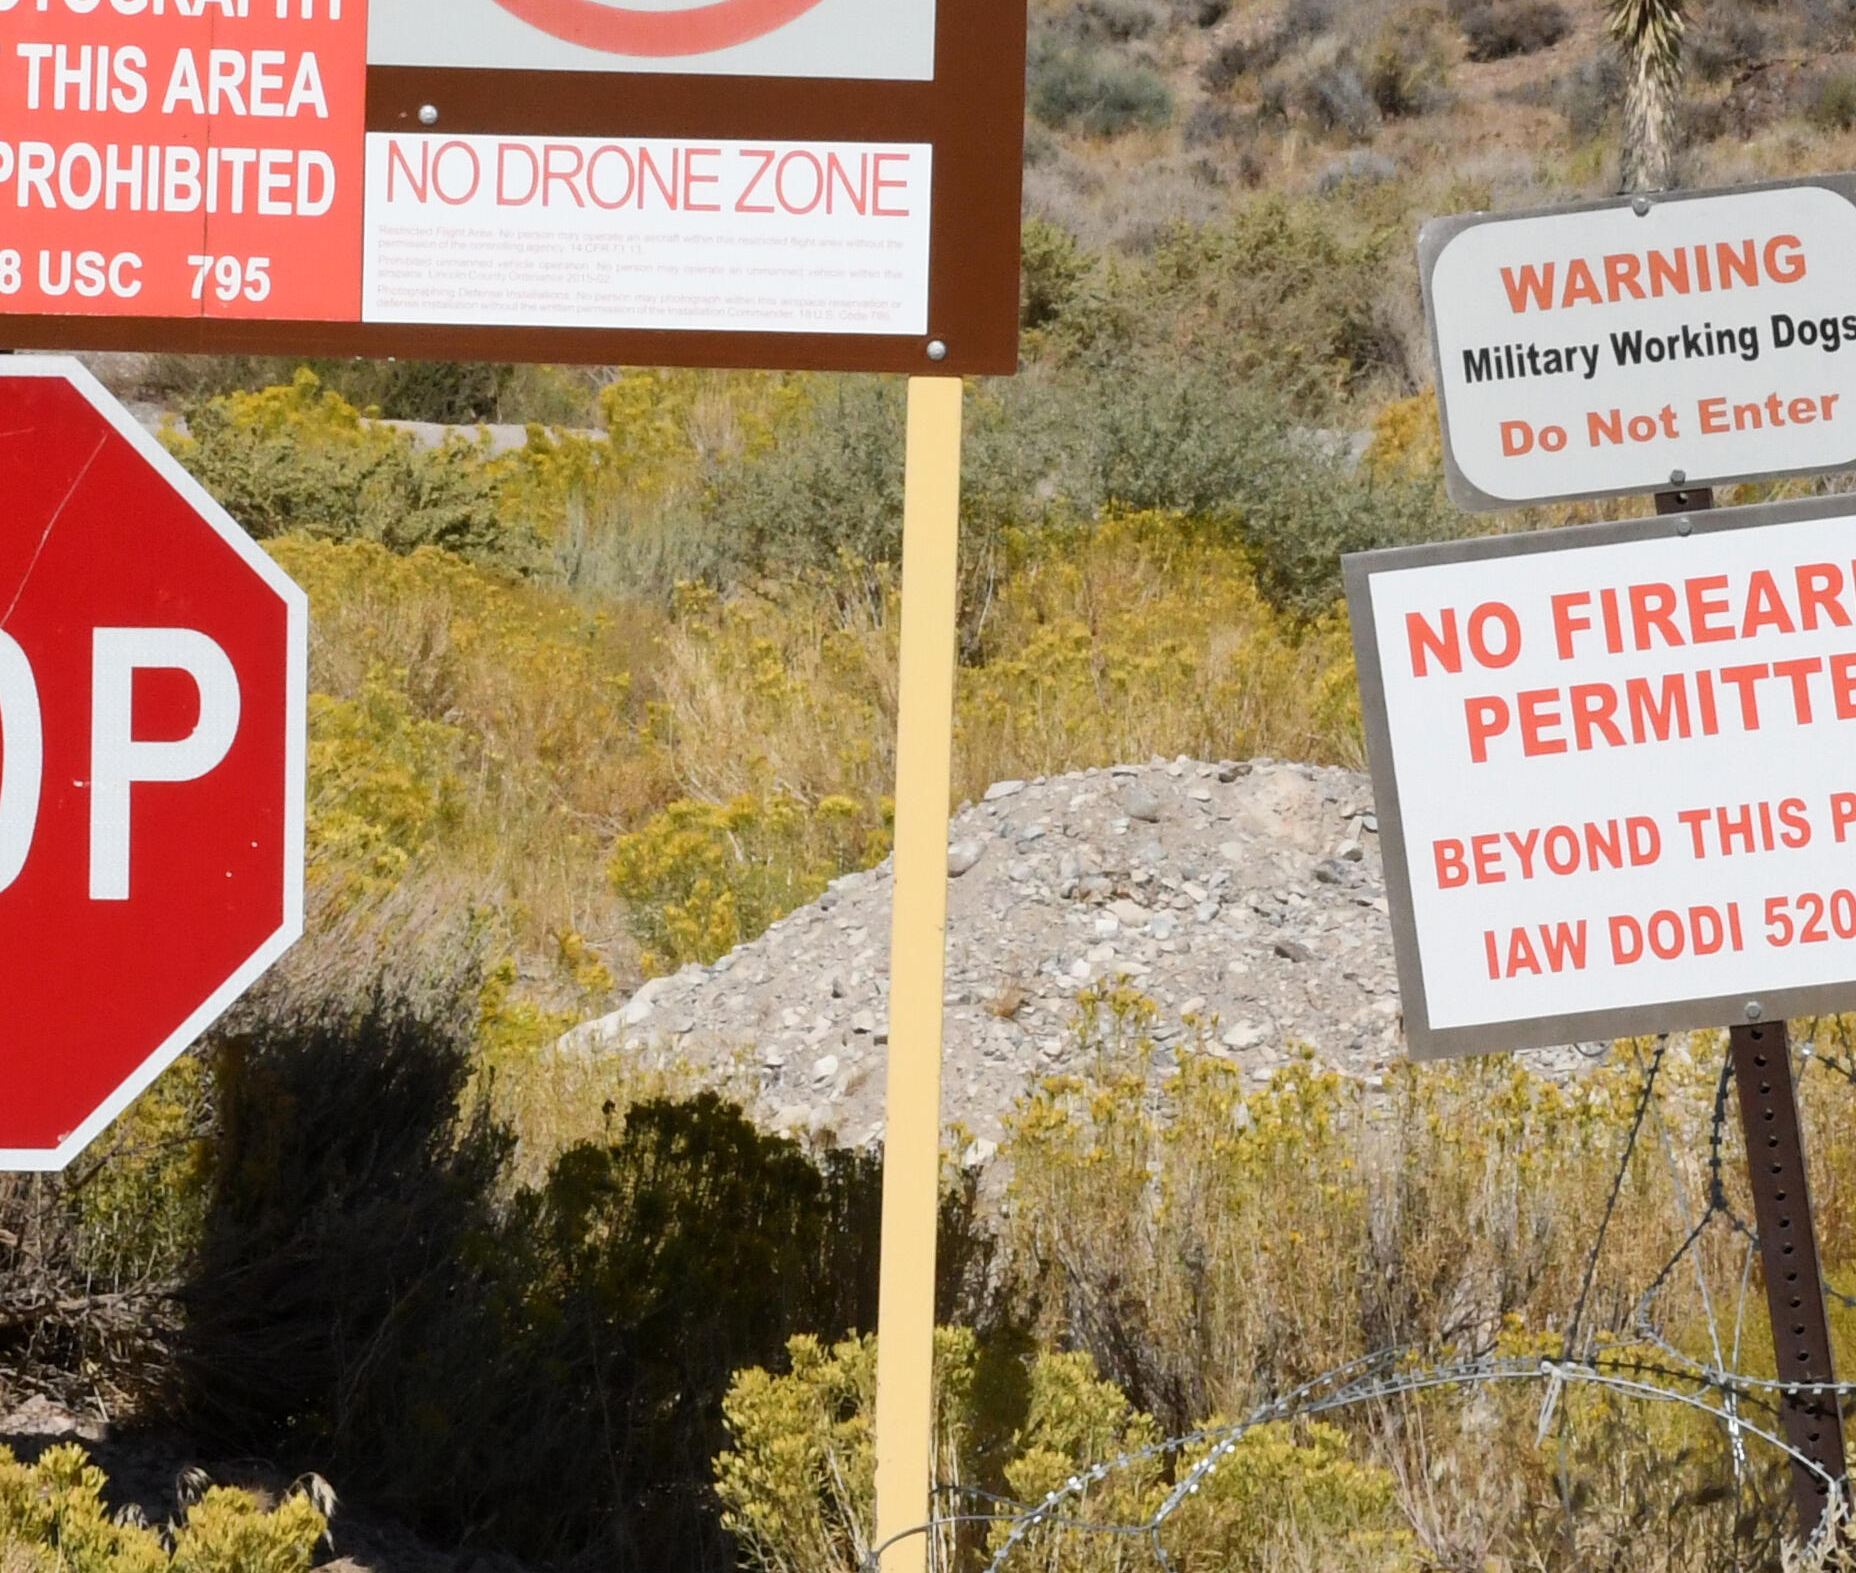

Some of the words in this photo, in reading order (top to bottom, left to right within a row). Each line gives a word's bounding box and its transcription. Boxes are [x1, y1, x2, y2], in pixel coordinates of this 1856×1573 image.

[17, 43, 147, 113] THIS
[162, 48, 328, 118] AREA
[386, 140, 480, 206] NO
[493, 143, 721, 212] DRONE
[735, 150, 909, 216] ZONE
[39, 250, 142, 297] USC
[188, 255, 270, 301] 795
[1500, 235, 1806, 313] WARNING
[1463, 344, 1598, 383] Military
[1610, 323, 1759, 365] Working
[1500, 421, 1567, 456] Do
[1587, 405, 1679, 447] Not
[1698, 393, 1839, 434] Enter
[1406, 602, 1521, 677] NO
[1433, 817, 1661, 889] BEYOND
[1678, 798, 1811, 858] THIS
[1485, 920, 1586, 979] IAW
[1609, 902, 1743, 965] DODI
